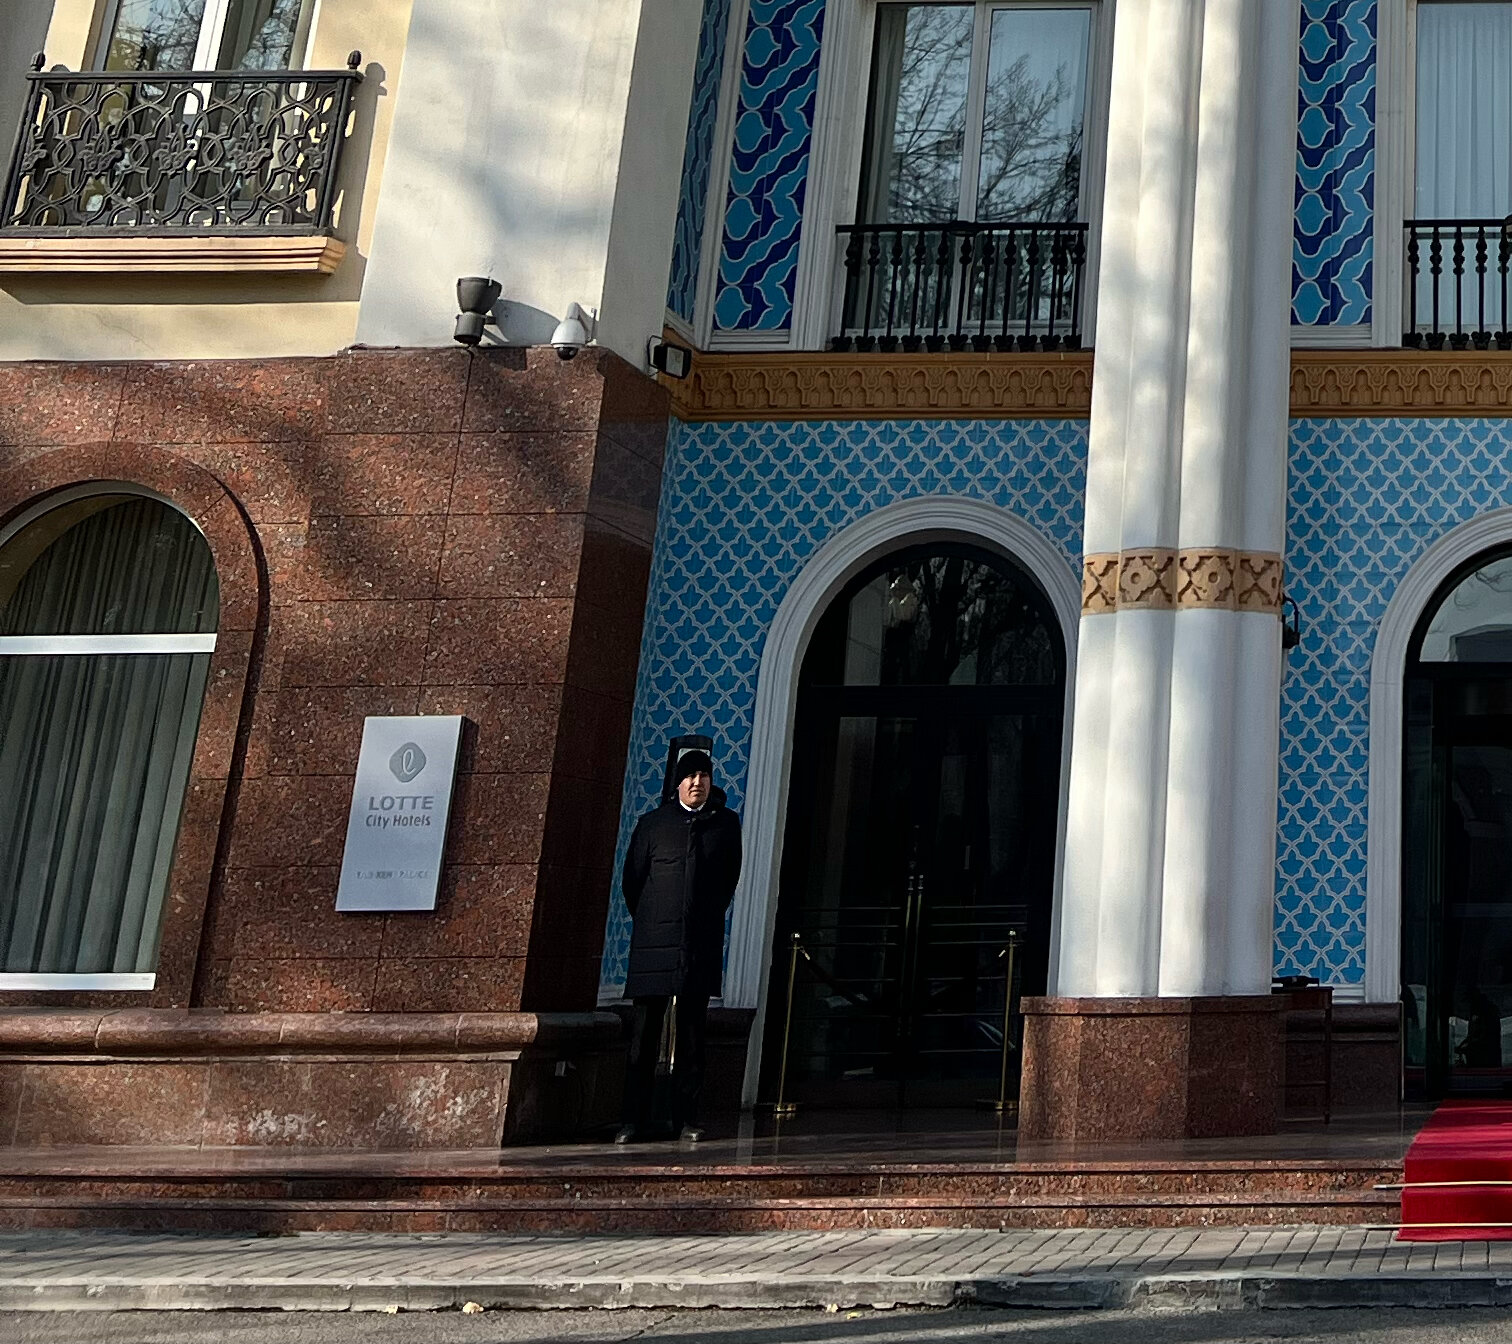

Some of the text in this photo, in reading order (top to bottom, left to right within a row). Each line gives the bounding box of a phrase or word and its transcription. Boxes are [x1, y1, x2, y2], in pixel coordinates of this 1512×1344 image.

[368, 795, 435, 811] LOTTE
[365, 814, 432, 830] City Hotels
